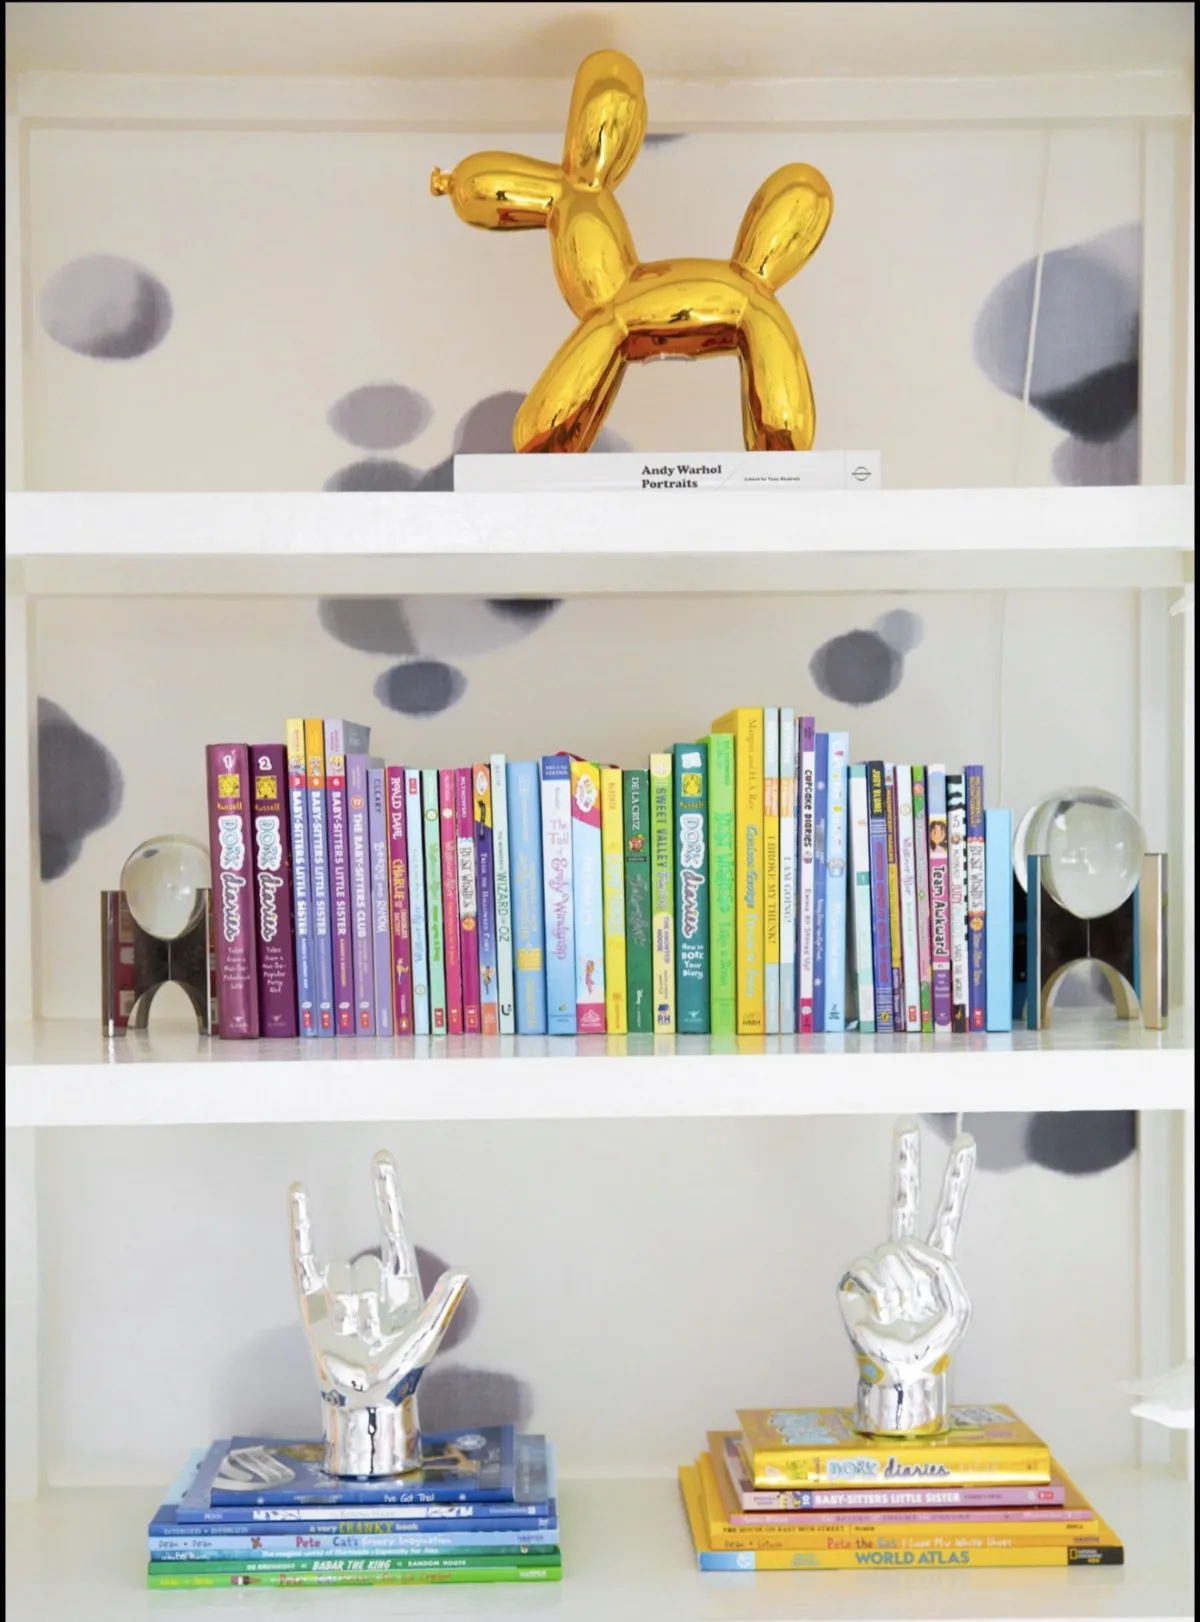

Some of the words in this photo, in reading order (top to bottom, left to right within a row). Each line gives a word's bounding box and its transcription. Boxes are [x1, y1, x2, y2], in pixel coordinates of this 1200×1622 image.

[641, 466, 674, 478] Andy
[677, 465, 722, 475] Warhol
[641, 479, 698, 489] Portraits
[258, 756, 272, 770] 2
[873, 769, 882, 787] JUDY
[373, 779, 382, 813] CLEARY
[391, 777, 403, 808] ROALD
[631, 777, 640, 791] DE
[631, 792, 640, 804] LA
[656, 787, 667, 823] SWEET
[873, 789, 882, 813] BLUME
[292, 791, 304, 862] BABY-SITTERS
[311, 791, 324, 862] BABY-SITTERS
[332, 791, 344, 862] BABY-SITTERS
[353, 814, 363, 832] THE
[392, 812, 403, 840] DAHL
[632, 805, 641, 830] CRUZ
[219, 818, 242, 869] DORK
[256, 818, 281, 869] DORK
[657, 828, 668, 867] VALLEY
[682, 816, 702, 867] DORK
[747, 824, 758, 868] Curious
[354, 836, 366, 908] BABY-SITTERS
[767, 842, 776, 879] BROKE
[970, 846, 982, 870] BEST
[295, 867, 306, 897] LITTLE
[315, 867, 326, 897] LITTLE
[335, 867, 346, 897] LITTLE
[392, 859, 405, 900] CHARLIE
[549, 858, 569, 893] Emily
[784, 866, 791, 881] AM
[933, 866, 944, 896] Team
[497, 874, 509, 916] WIZARD
[682, 870, 703, 938] diaries
[745, 869, 758, 909] George
[768, 883, 776, 898] MY
[784, 884, 792, 923] GOING!
[222, 873, 246, 941] diaries
[259, 873, 283, 942] diaries
[296, 901, 309, 935] SISTER
[316, 901, 328, 935] SISTER
[337, 901, 347, 935] SISTER
[357, 910, 367, 937] CLUB
[499, 926, 510, 943] OZ
[768, 903, 777, 944] TRUNK!
[934, 901, 948, 954] Awkward
[681, 951, 704, 960] DORK
[684, 960, 702, 969] Your
[682, 969, 703, 980] Diary
[828, 1460, 879, 1478] DORK
[884, 1457, 951, 1477] diaries
[384, 1493, 396, 1503] I've
[400, 1493, 413, 1503] Got
[815, 1493, 889, 1505] BABY-SITTERS
[890, 1493, 922, 1503] LITTLE
[925, 1492, 961, 1502] SISTER
[296, 1536, 321, 1548] Pete
[333, 1536, 359, 1548] Cat's
[318, 1525, 337, 1534] very
[396, 1523, 418, 1531] book
[827, 1537, 852, 1549] Pete
[855, 1537, 873, 1548] the
[876, 1537, 898, 1548] Cat
[312, 1561, 346, 1571] BABAR
[347, 1560, 366, 1571] THE
[368, 1559, 392, 1570] KING
[855, 1552, 915, 1564] WORLD
[918, 1551, 971, 1563] ATLAS
